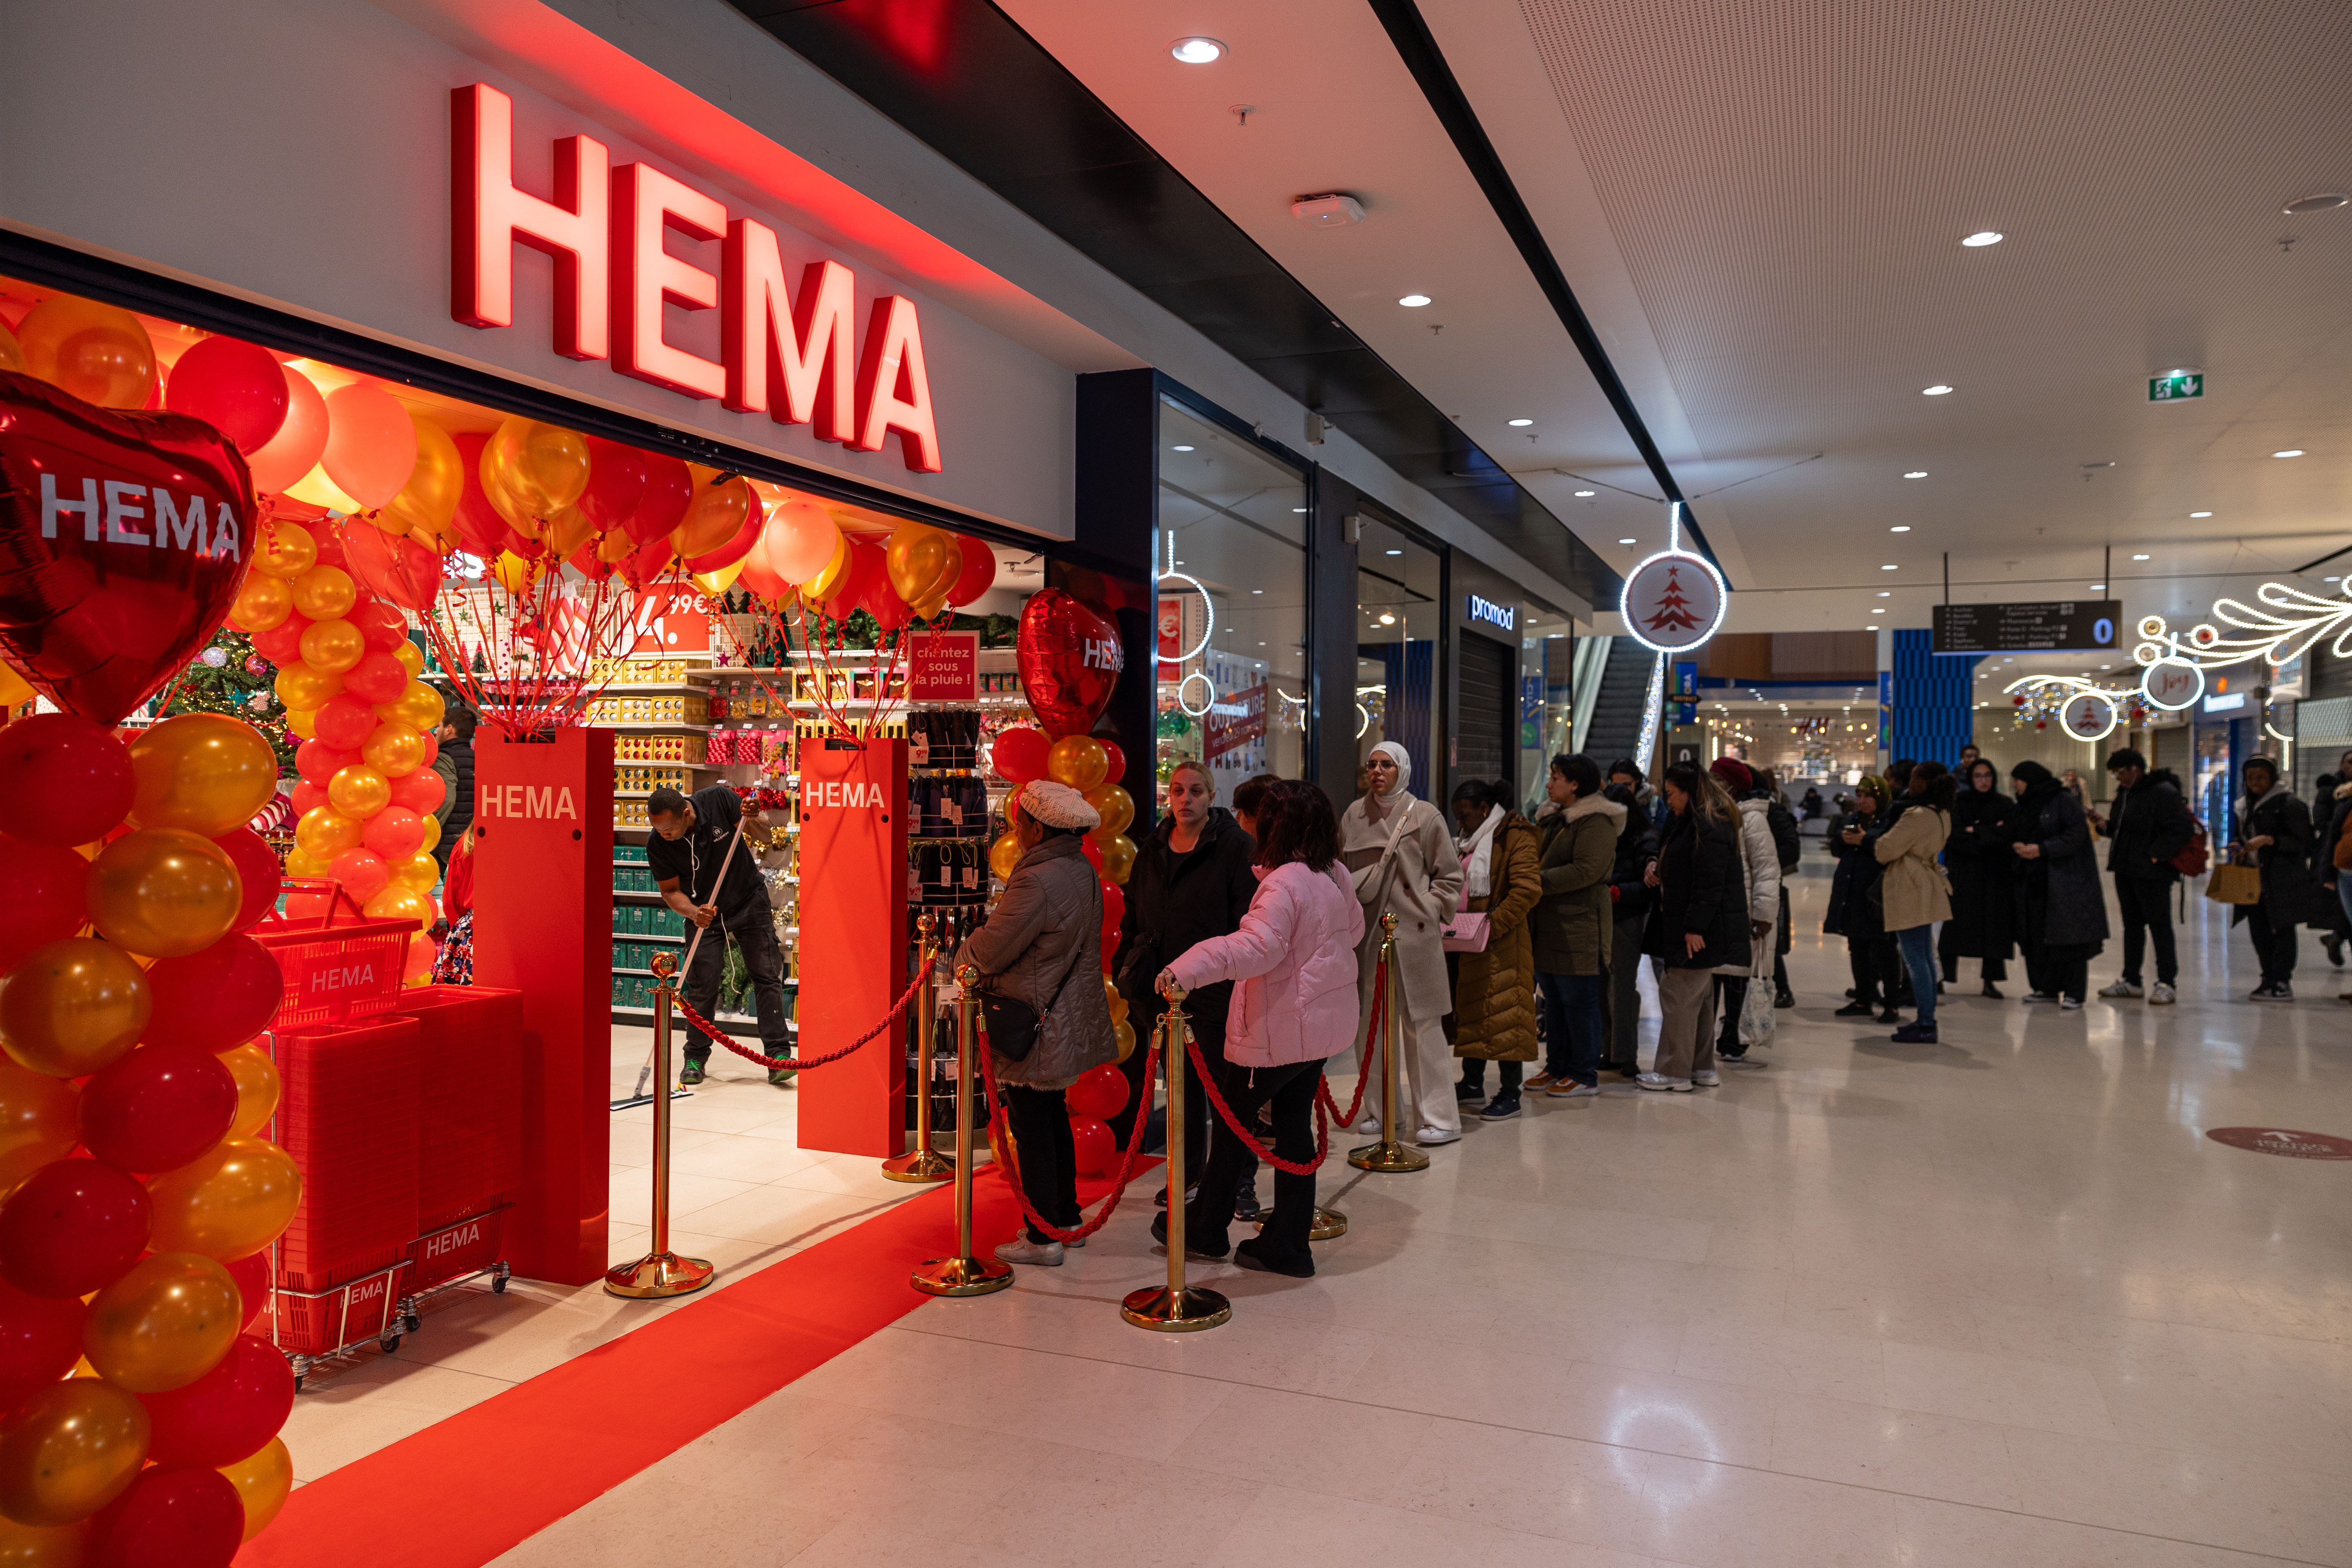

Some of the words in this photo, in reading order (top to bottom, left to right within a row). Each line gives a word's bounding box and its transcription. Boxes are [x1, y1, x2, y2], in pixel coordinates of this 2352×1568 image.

[450, 81, 942, 474] HEMA
[40, 473, 240, 563] HEMA
[1472, 594, 1514, 631] promod
[2093, 618, 2113, 644] 0
[916, 674, 927, 685] la
[931, 673, 963, 687] pluie
[967, 674, 971, 685] !
[928, 663, 959, 671] sous
[1210, 692, 1266, 732] OUVEURE
[1234, 726, 1240, 740] 29
[916, 749, 928, 759] 9.99
[481, 784, 577, 820] HEMA
[805, 782, 885, 808] HEMA
[908, 819, 919, 829] 9.99
[312, 964, 374, 993] HEMA
[426, 1223, 480, 1259] HEMA
